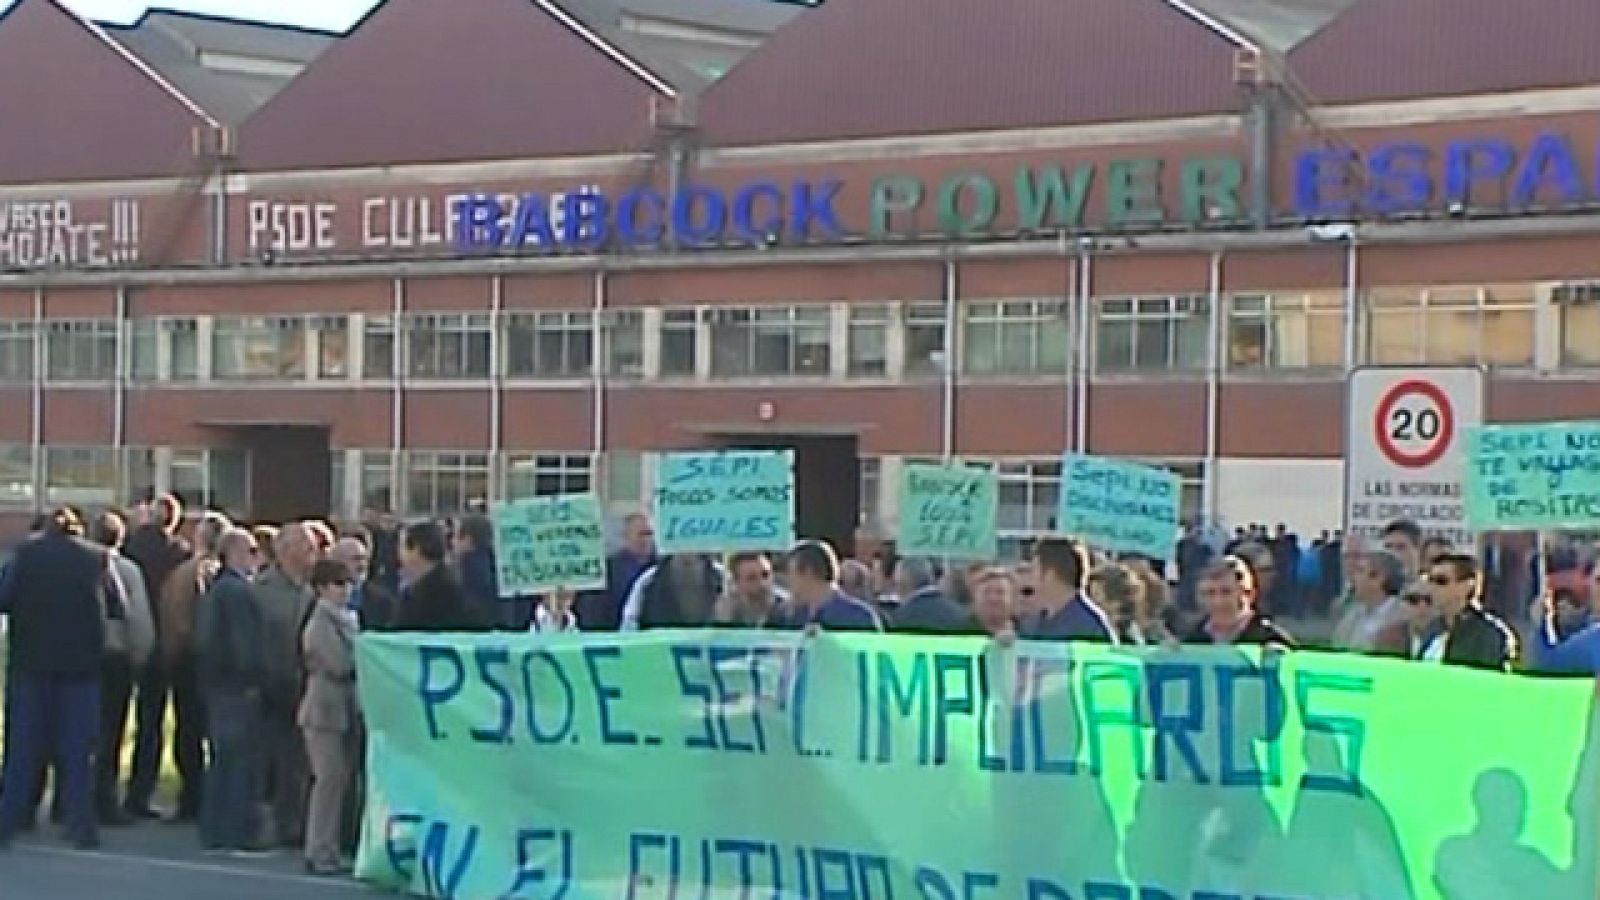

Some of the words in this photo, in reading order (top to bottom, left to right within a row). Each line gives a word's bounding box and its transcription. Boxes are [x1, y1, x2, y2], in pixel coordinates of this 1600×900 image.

[456, 176, 844, 250] BABCOCK
[868, 157, 1244, 240] POWER
[1293, 128, 1600, 217] ESPA
[250, 198, 336, 248] PSOE
[1391, 407, 1440, 441] 20
[1363, 479, 1392, 497] LAS
[1399, 481, 1463, 498] NORMAS
[1351, 503, 1371, 520] DE
[1376, 503, 1466, 521] CIRCULACIO
[856, 650, 1375, 797] IMPLICAROS
